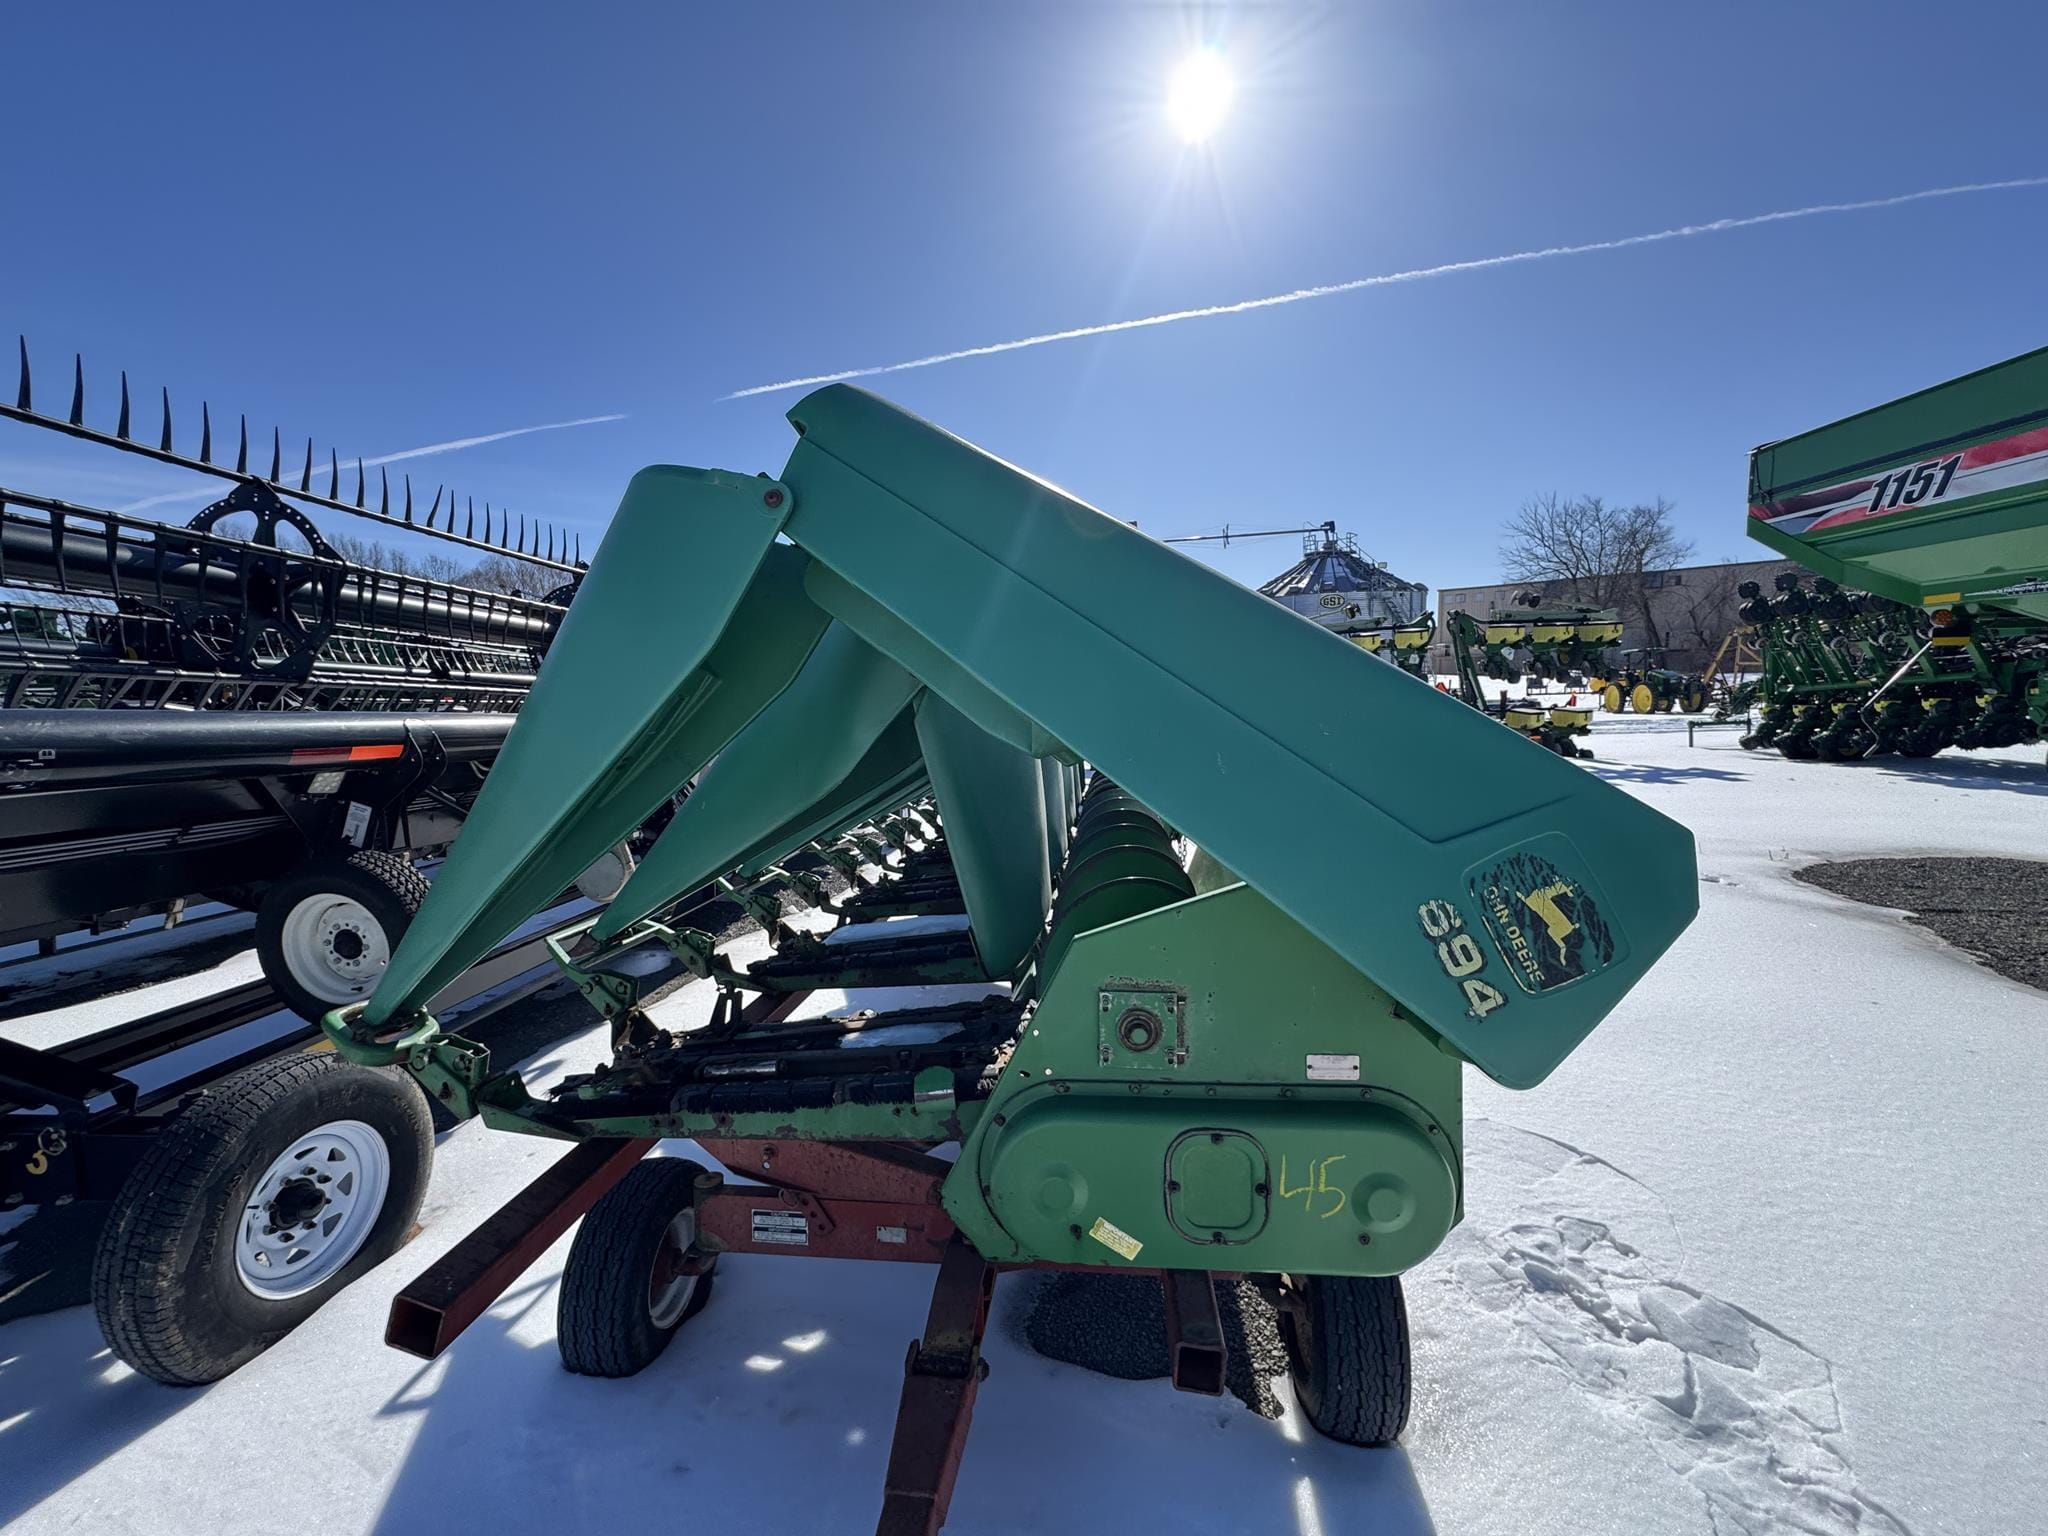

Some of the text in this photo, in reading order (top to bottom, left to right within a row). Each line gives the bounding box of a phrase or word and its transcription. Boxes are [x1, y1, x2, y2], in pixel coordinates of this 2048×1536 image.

[1866, 453, 1964, 515] 1151
[1323, 596, 1342, 606] GSI
[1279, 1154, 1346, 1219] 45
